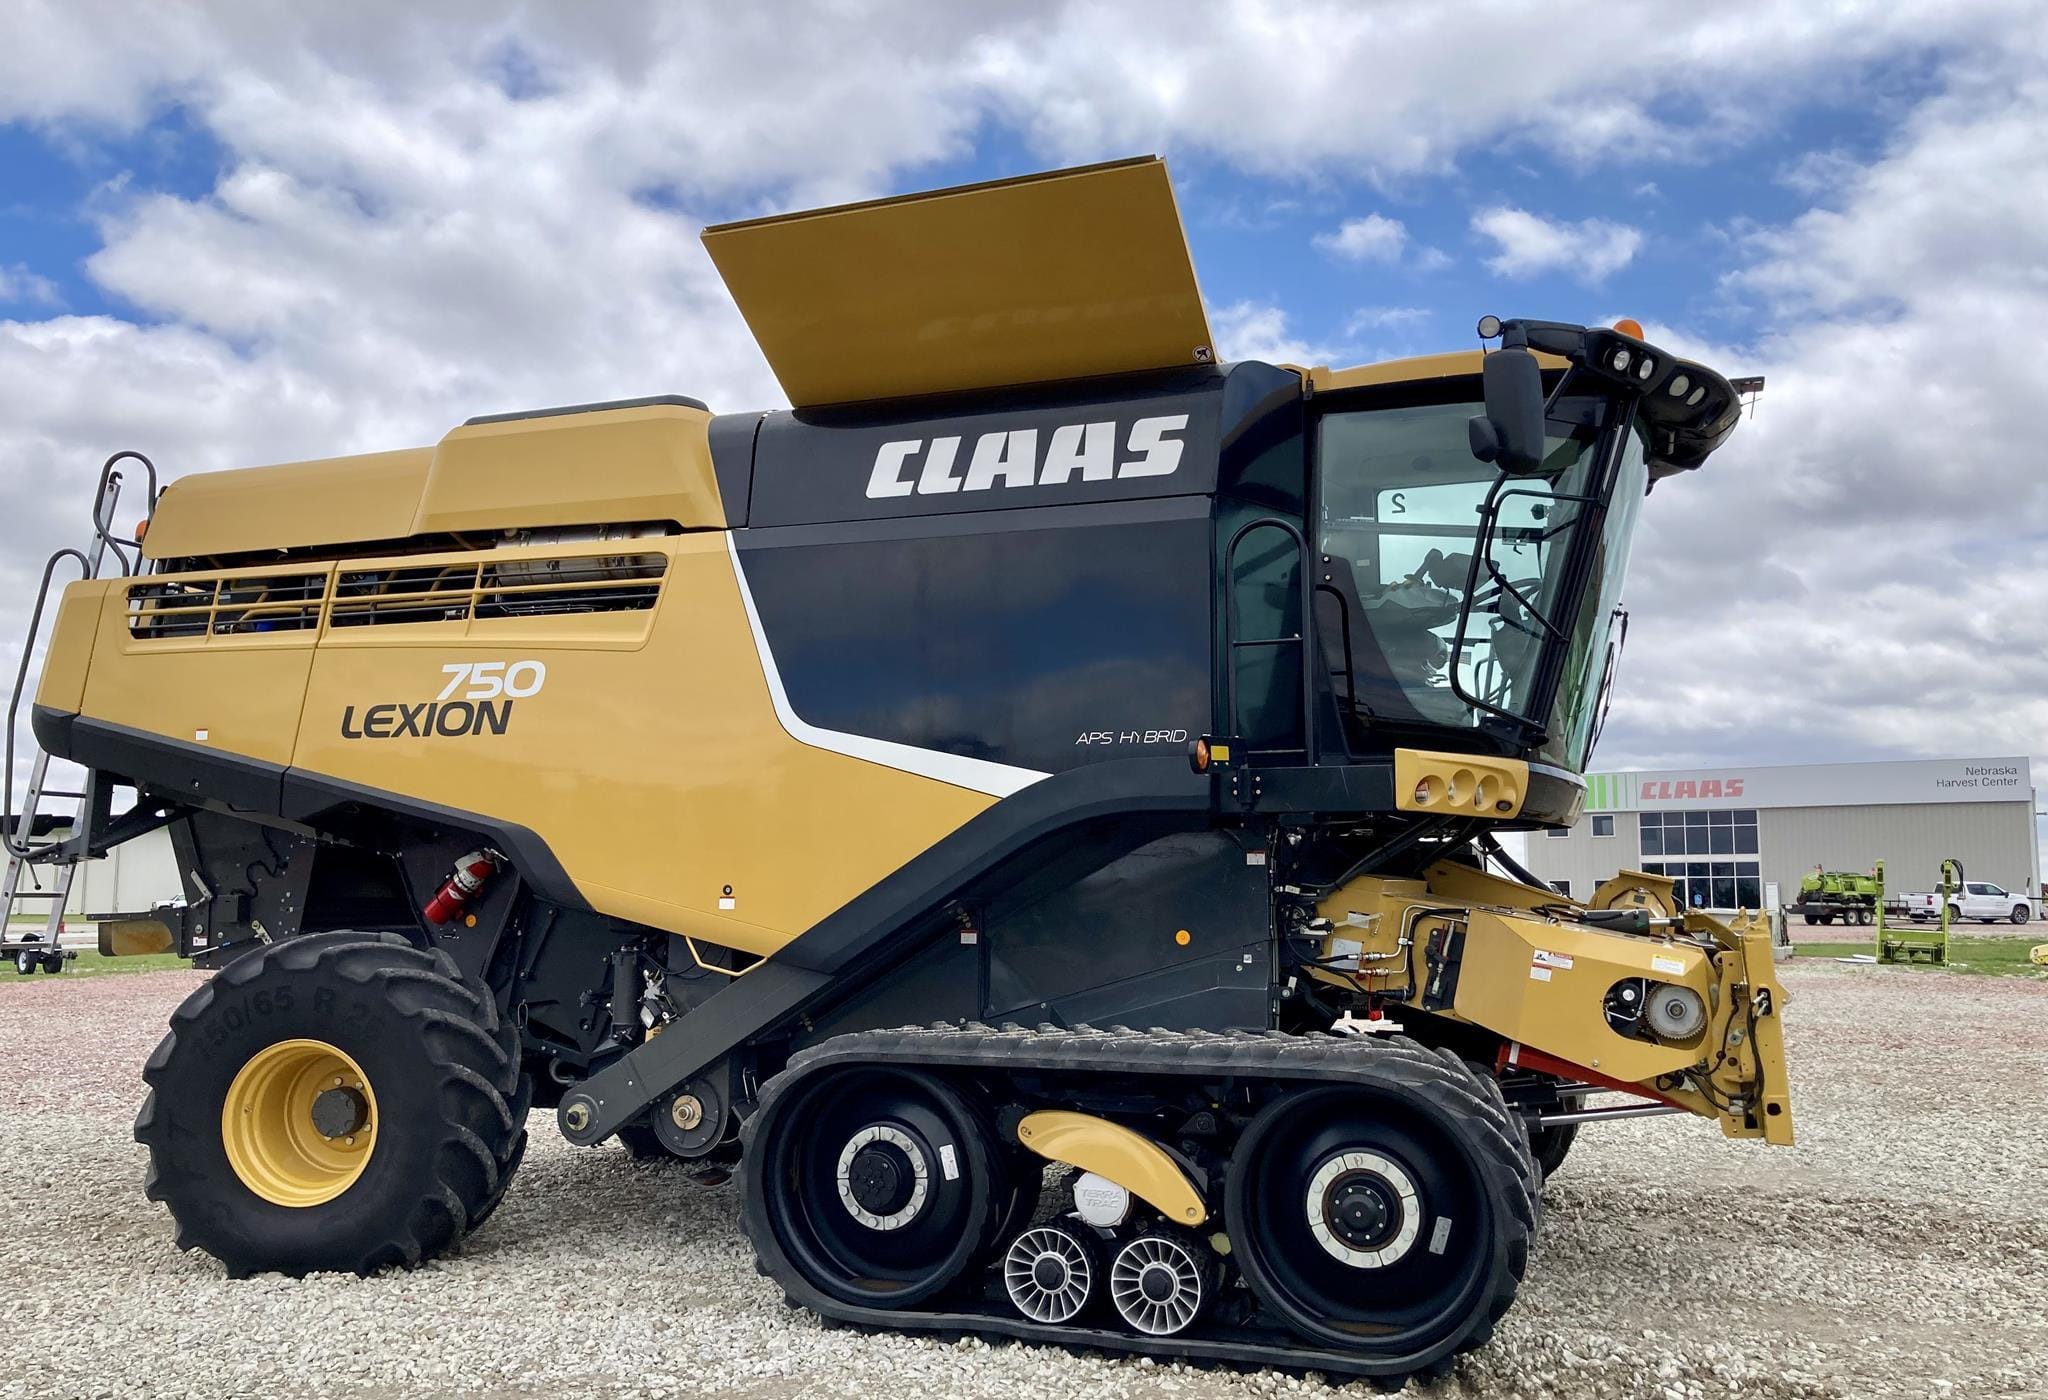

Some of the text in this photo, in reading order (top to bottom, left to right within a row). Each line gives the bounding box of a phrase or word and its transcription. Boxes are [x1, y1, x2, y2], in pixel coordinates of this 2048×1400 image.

[865, 414, 1190, 499] CLAAS
[436, 660, 546, 700] 750
[341, 700, 513, 739] LEXION
[1075, 729, 1187, 745] APS HYBRID
[1965, 766, 2018, 776] Nebraska
[1640, 779, 1744, 800] CLAAS
[1936, 777, 2018, 788] Harvest Center
